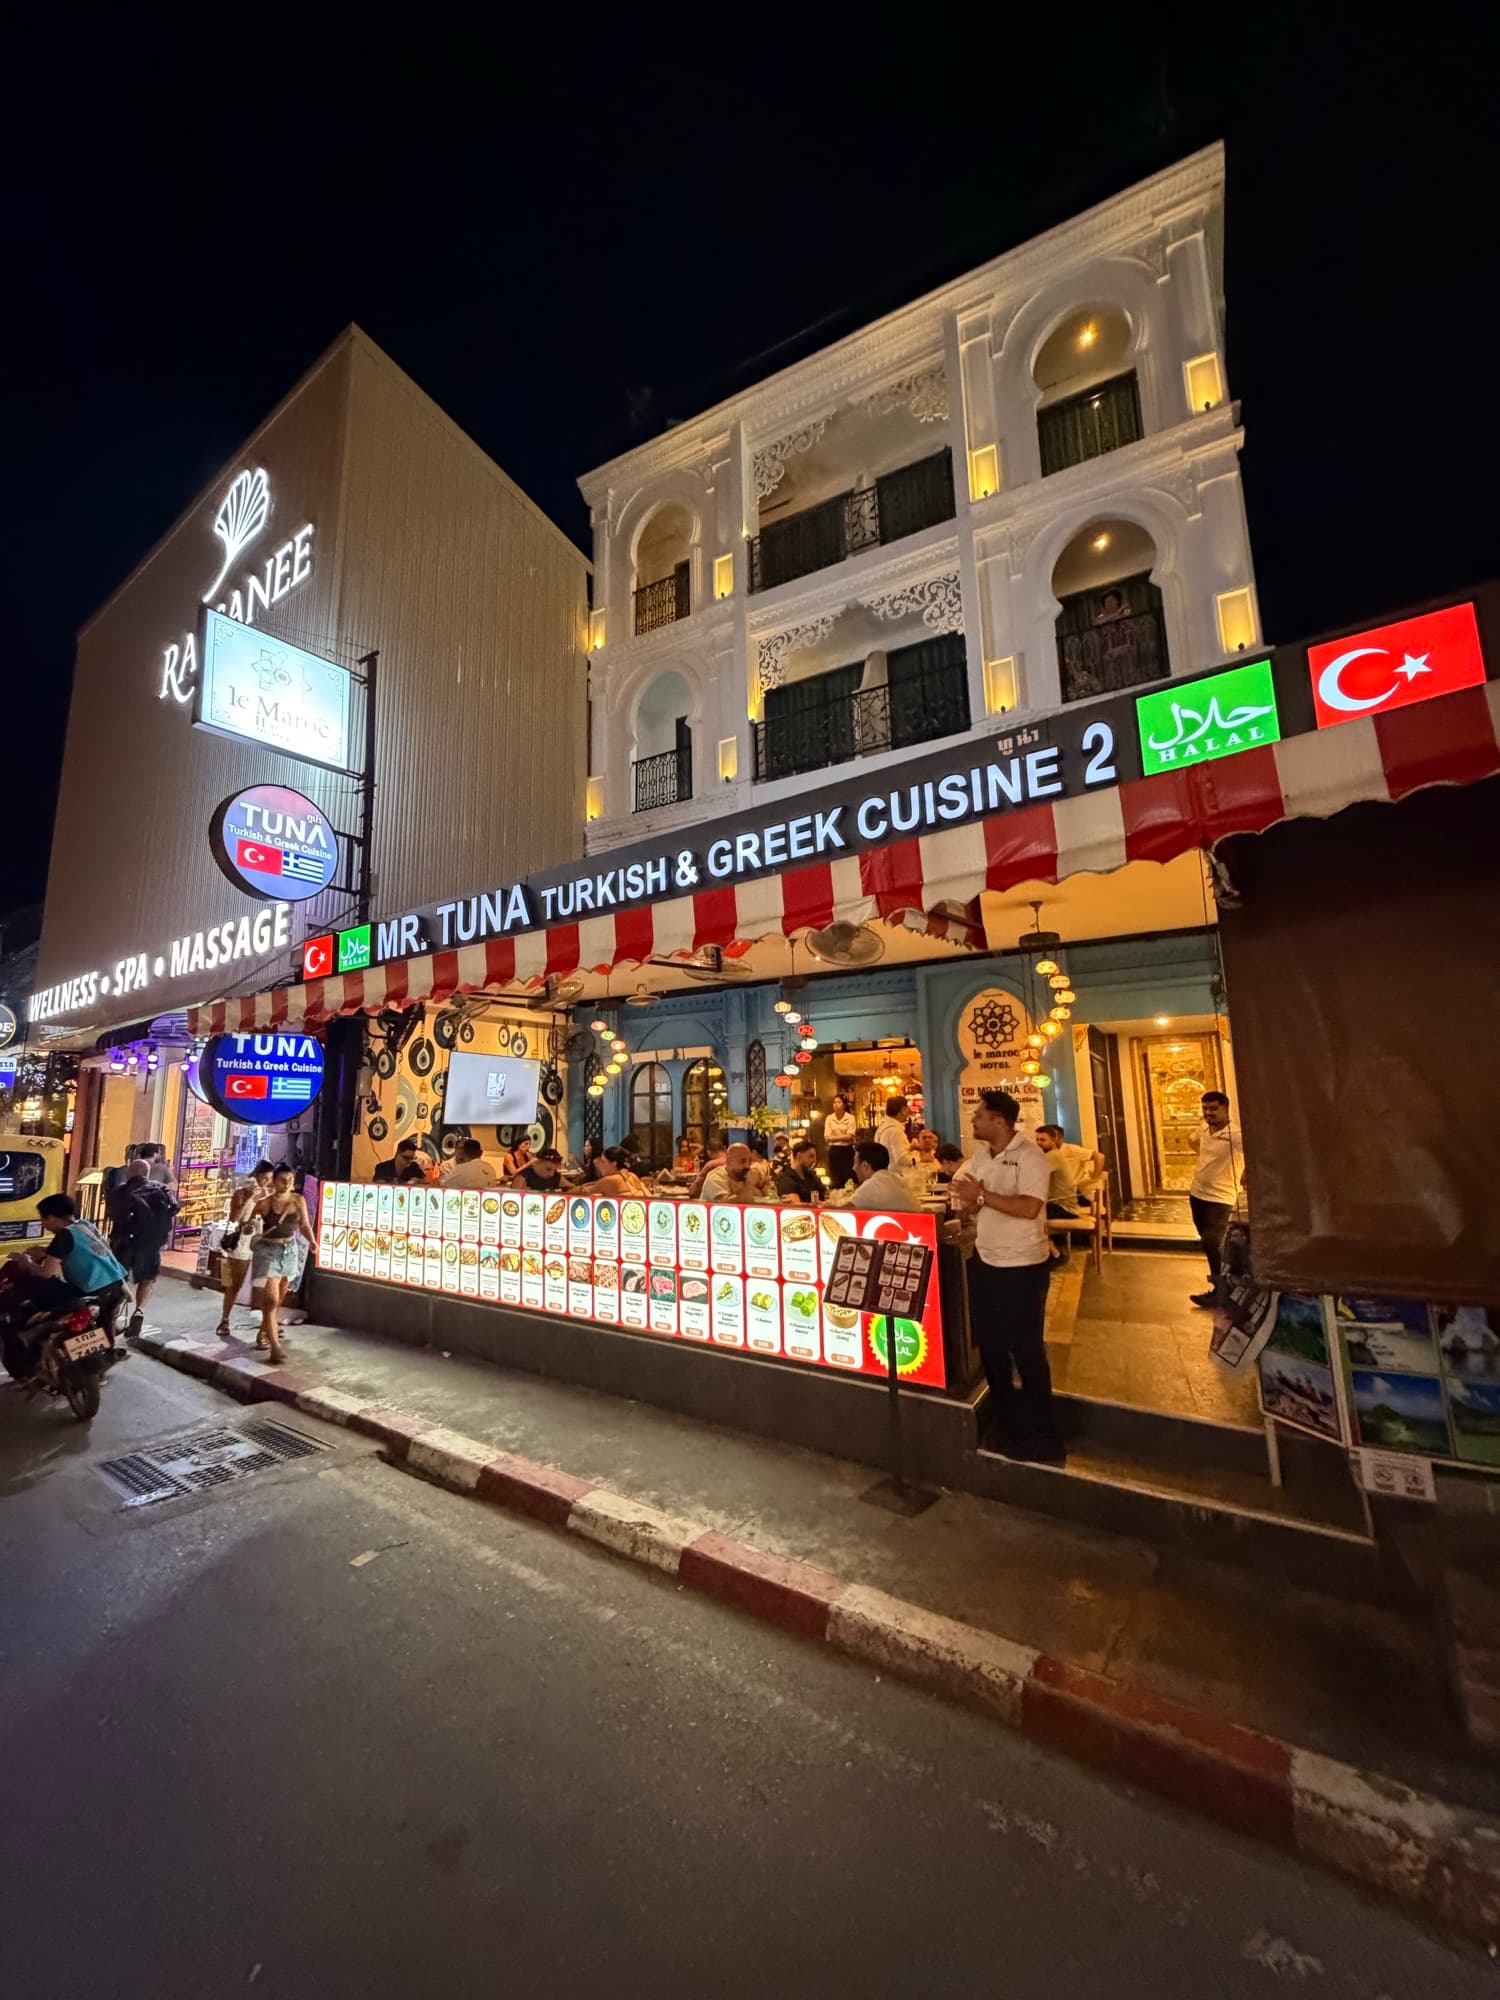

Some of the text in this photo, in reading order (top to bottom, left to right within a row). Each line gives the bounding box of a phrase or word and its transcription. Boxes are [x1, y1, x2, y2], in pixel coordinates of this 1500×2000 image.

[1147, 695, 1274, 750] حلال
[1158, 726, 1265, 764] HALAL
[228, 823, 333, 860] Turkish & Greek Cuisine
[239, 801, 328, 849] TUNA
[377, 721, 1117, 961] MR. TUNA TURKISH & GREEK CUISINE 2
[29, 903, 289, 1022] WELLNESS SPA MASSAGE
[342, 955, 368, 967] HALAL
[232, 1032, 316, 1059] TUNA
[973, 1049, 983, 1059] le
[216, 1058, 323, 1073] Turkish & Greek Cuisine
[980, 1062, 1011, 1070] HOTEL
